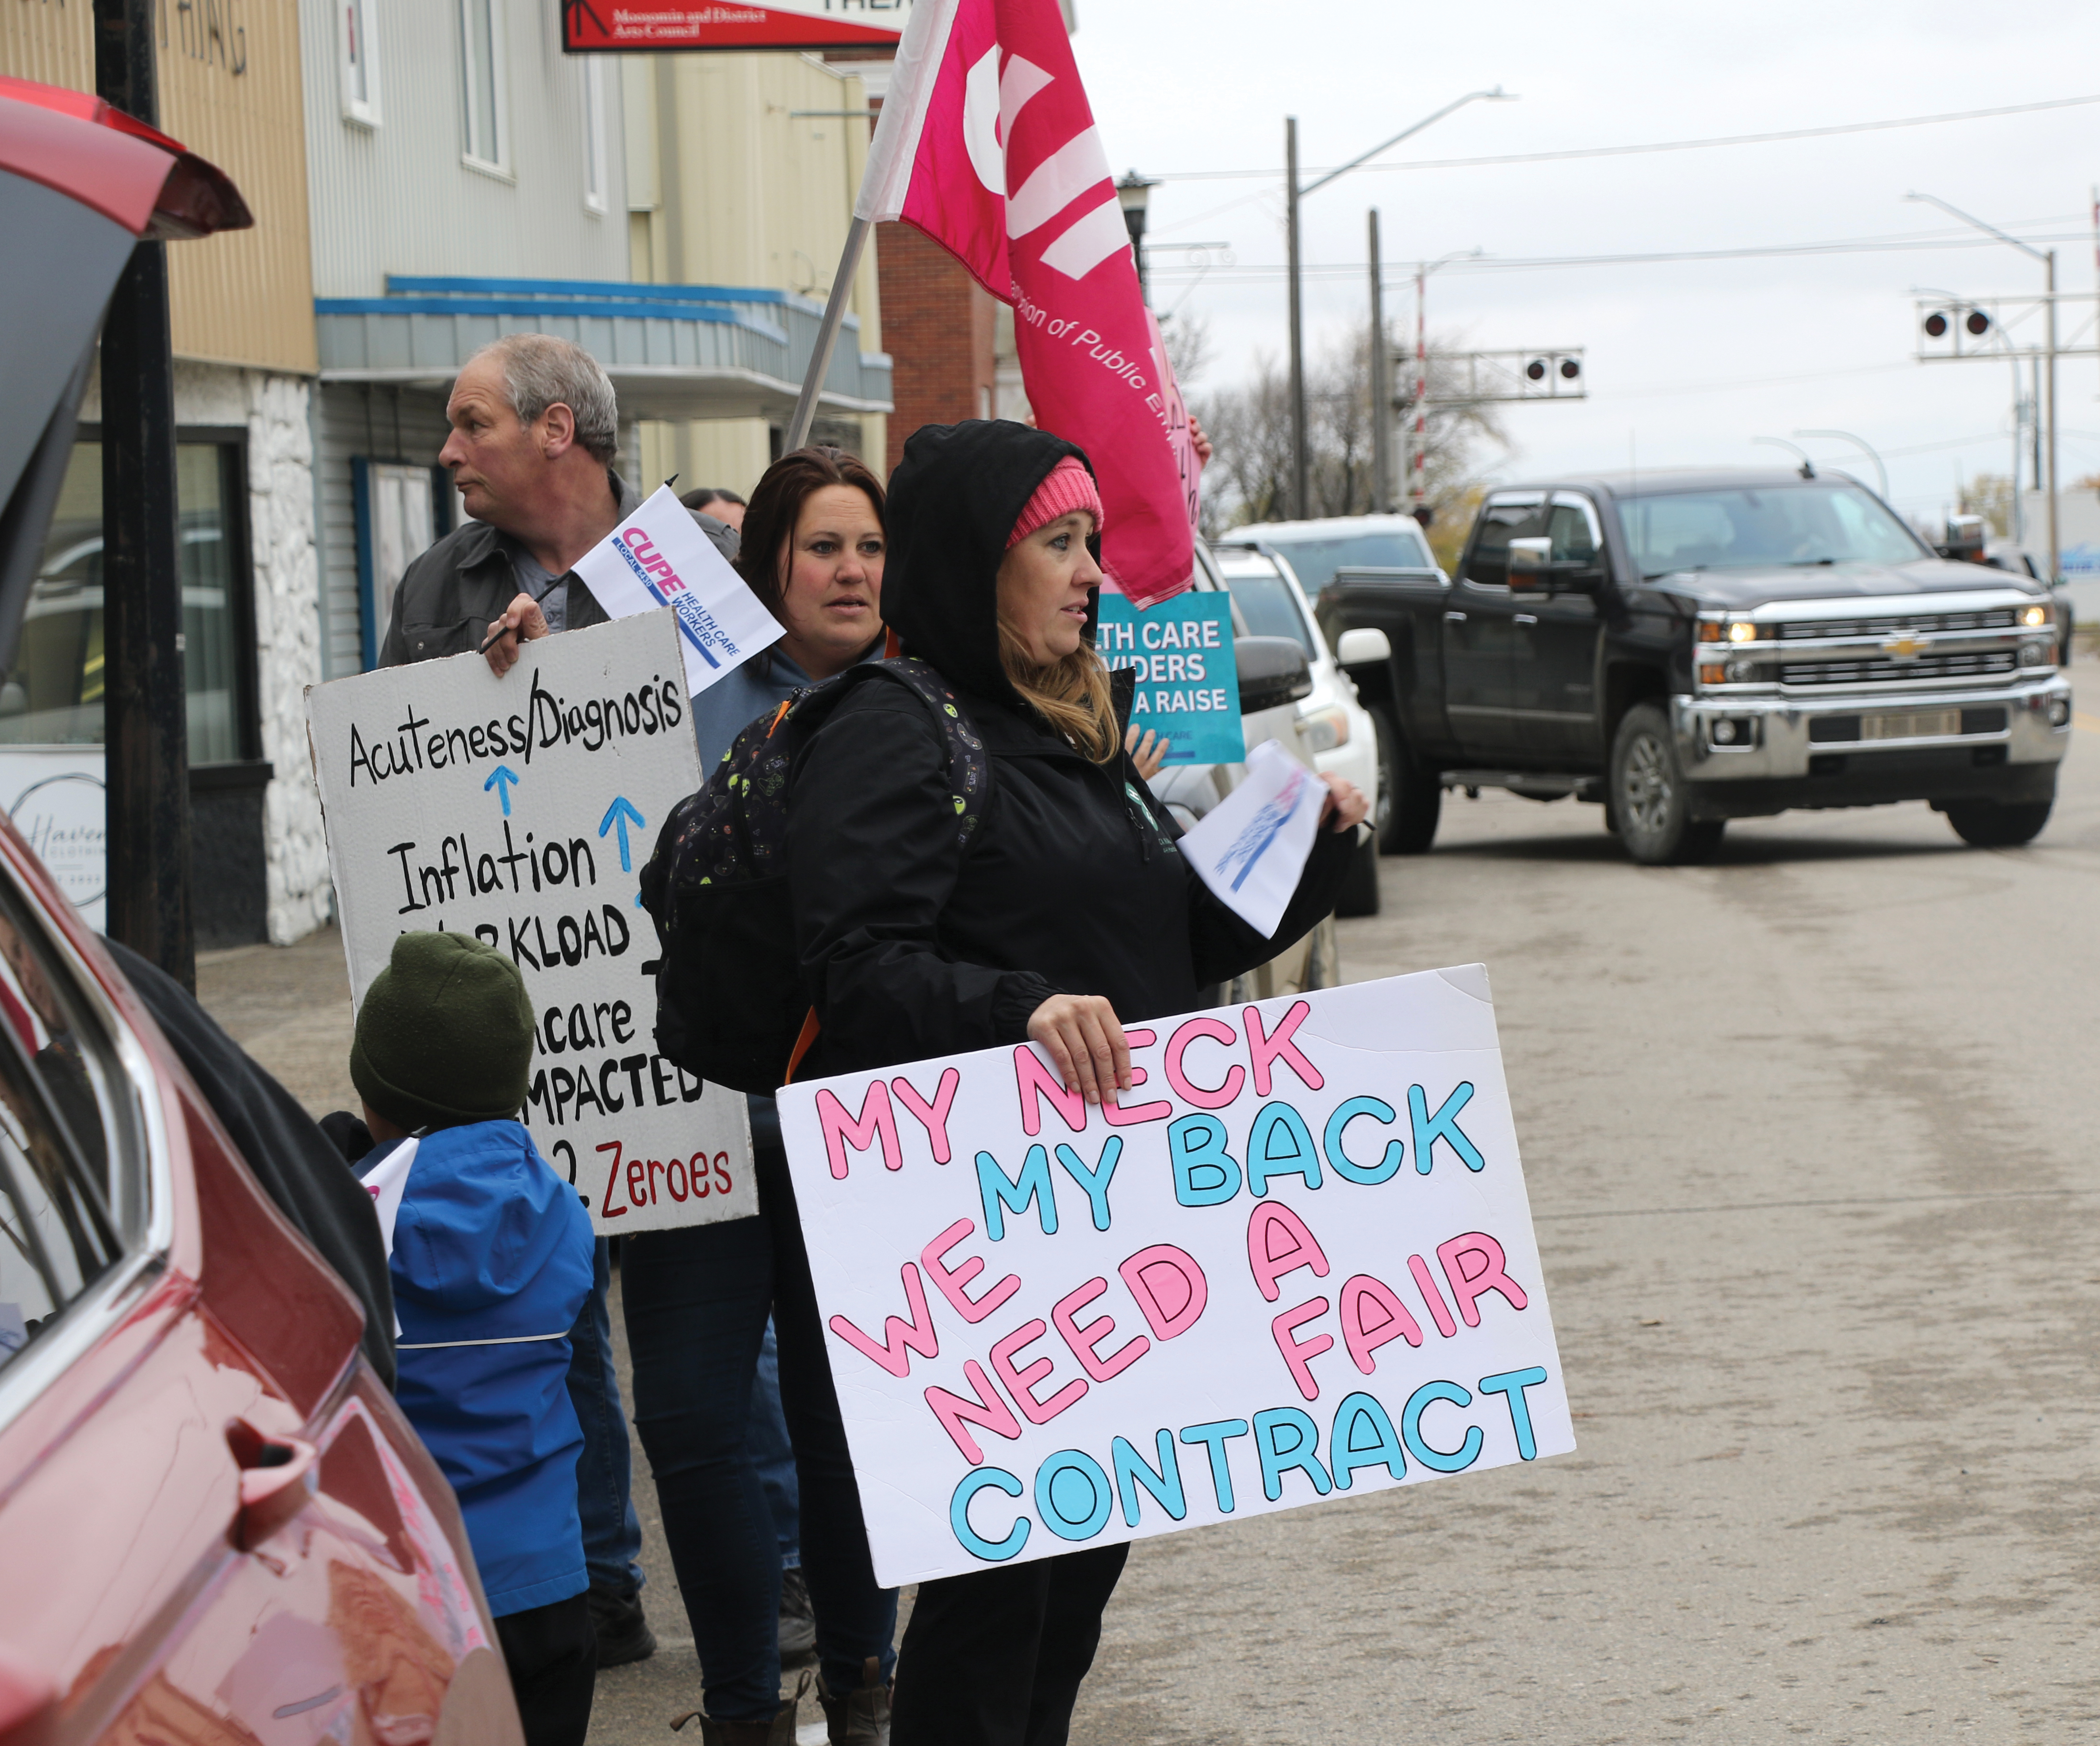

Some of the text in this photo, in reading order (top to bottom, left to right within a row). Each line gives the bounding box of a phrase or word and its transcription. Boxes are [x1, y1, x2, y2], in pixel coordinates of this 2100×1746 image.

[644, 23, 700, 39] Council
[686, 7, 711, 23] and
[1047, 319, 1080, 339] of
[1072, 329, 1147, 389] Public
[617, 542, 652, 587] LOCAL 5430
[622, 527, 686, 596] CUPE
[671, 596, 716, 648] WORKERS
[681, 592, 741, 657] HEALTH CARE
[1142, 620, 1222, 650] CARE
[1135, 688, 1229, 714] A RAISE
[387, 820, 596, 914] Inflation
[515, 1053, 703, 1125] MPACTED
[815, 1000, 1325, 1180] MY NECK
[596, 1141, 732, 1218] Zeroes
[975, 1080, 1486, 1242] MY BACK
[1246, 1200, 1330, 1302] A
[829, 1217, 1022, 1378] WE
[1271, 1231, 1529, 1401] FAIR
[924, 1242, 1208, 1466] NEED
[949, 1366, 1548, 1561] CONTRACT
